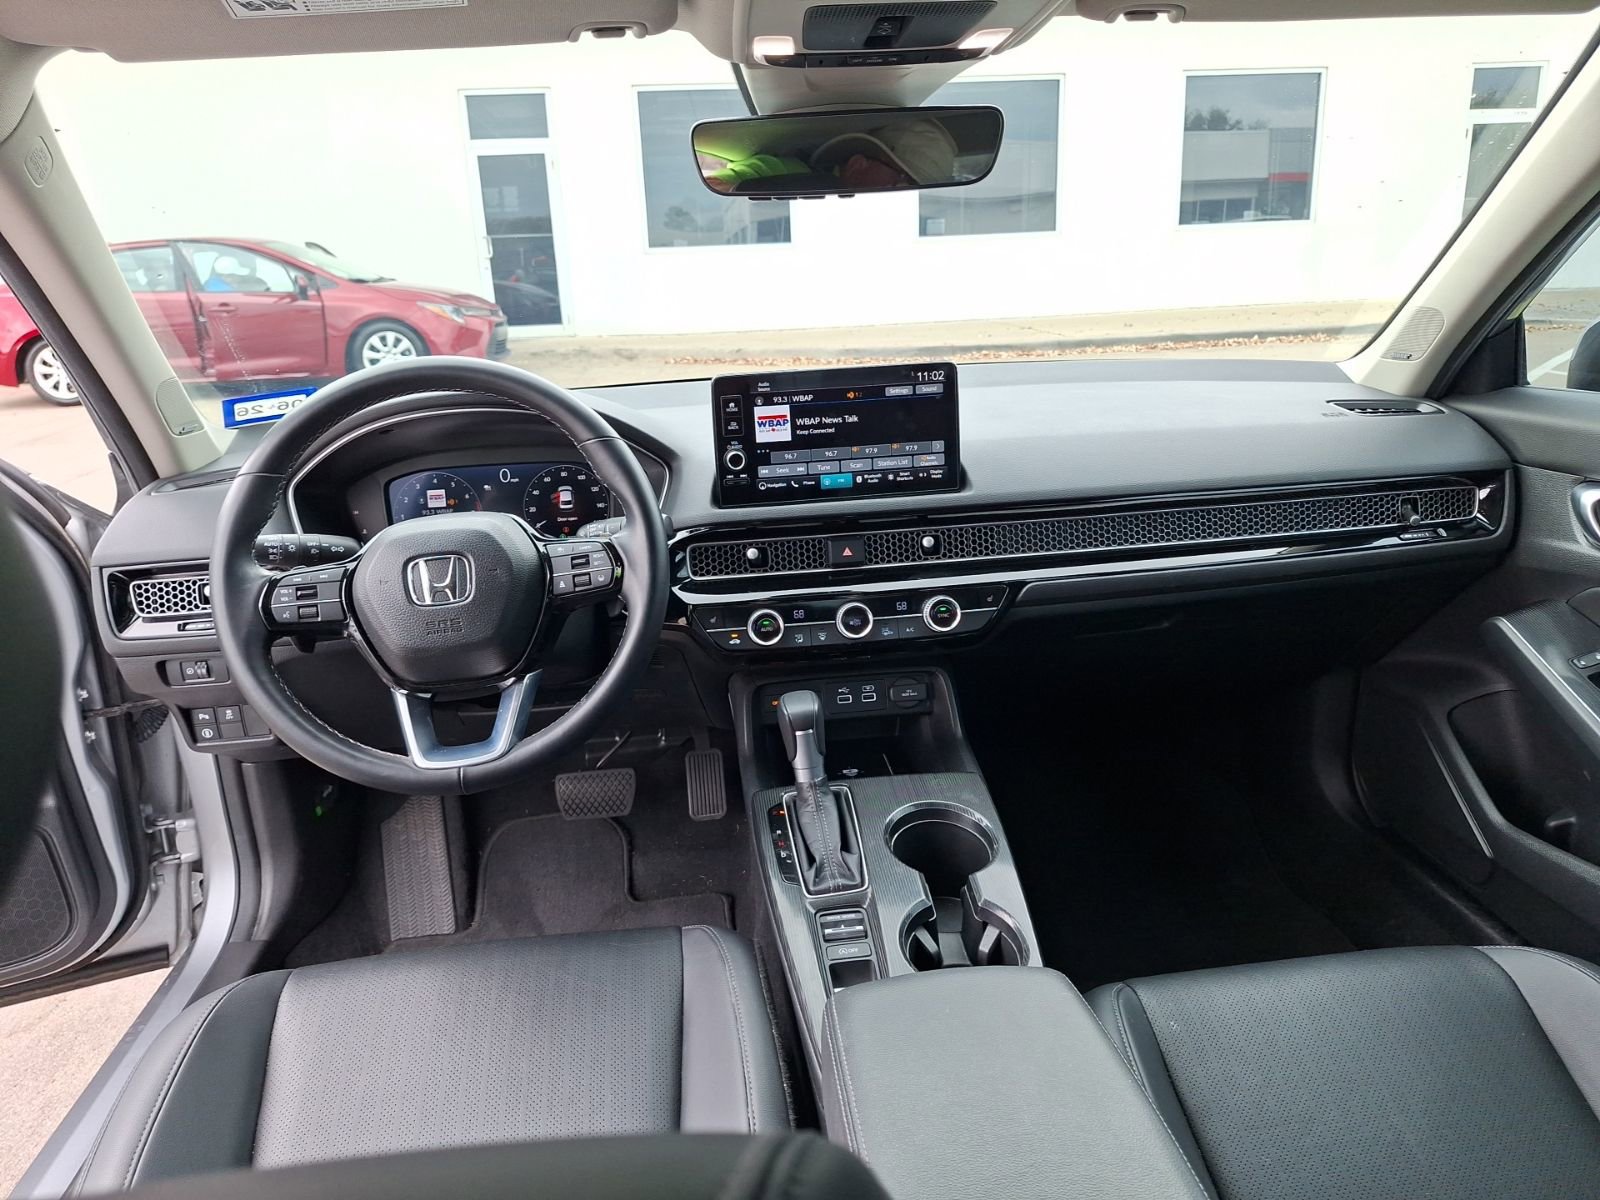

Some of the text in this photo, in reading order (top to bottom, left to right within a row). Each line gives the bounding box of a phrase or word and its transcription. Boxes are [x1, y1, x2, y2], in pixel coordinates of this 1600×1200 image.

[916, 370, 945, 381] 11:02
[757, 418, 789, 428] WBAP
[796, 414, 859, 426] WBAP News Talk
[500, 468, 511, 483] 0
[896, 602, 907, 611] 68
[793, 610, 805, 618] 68
